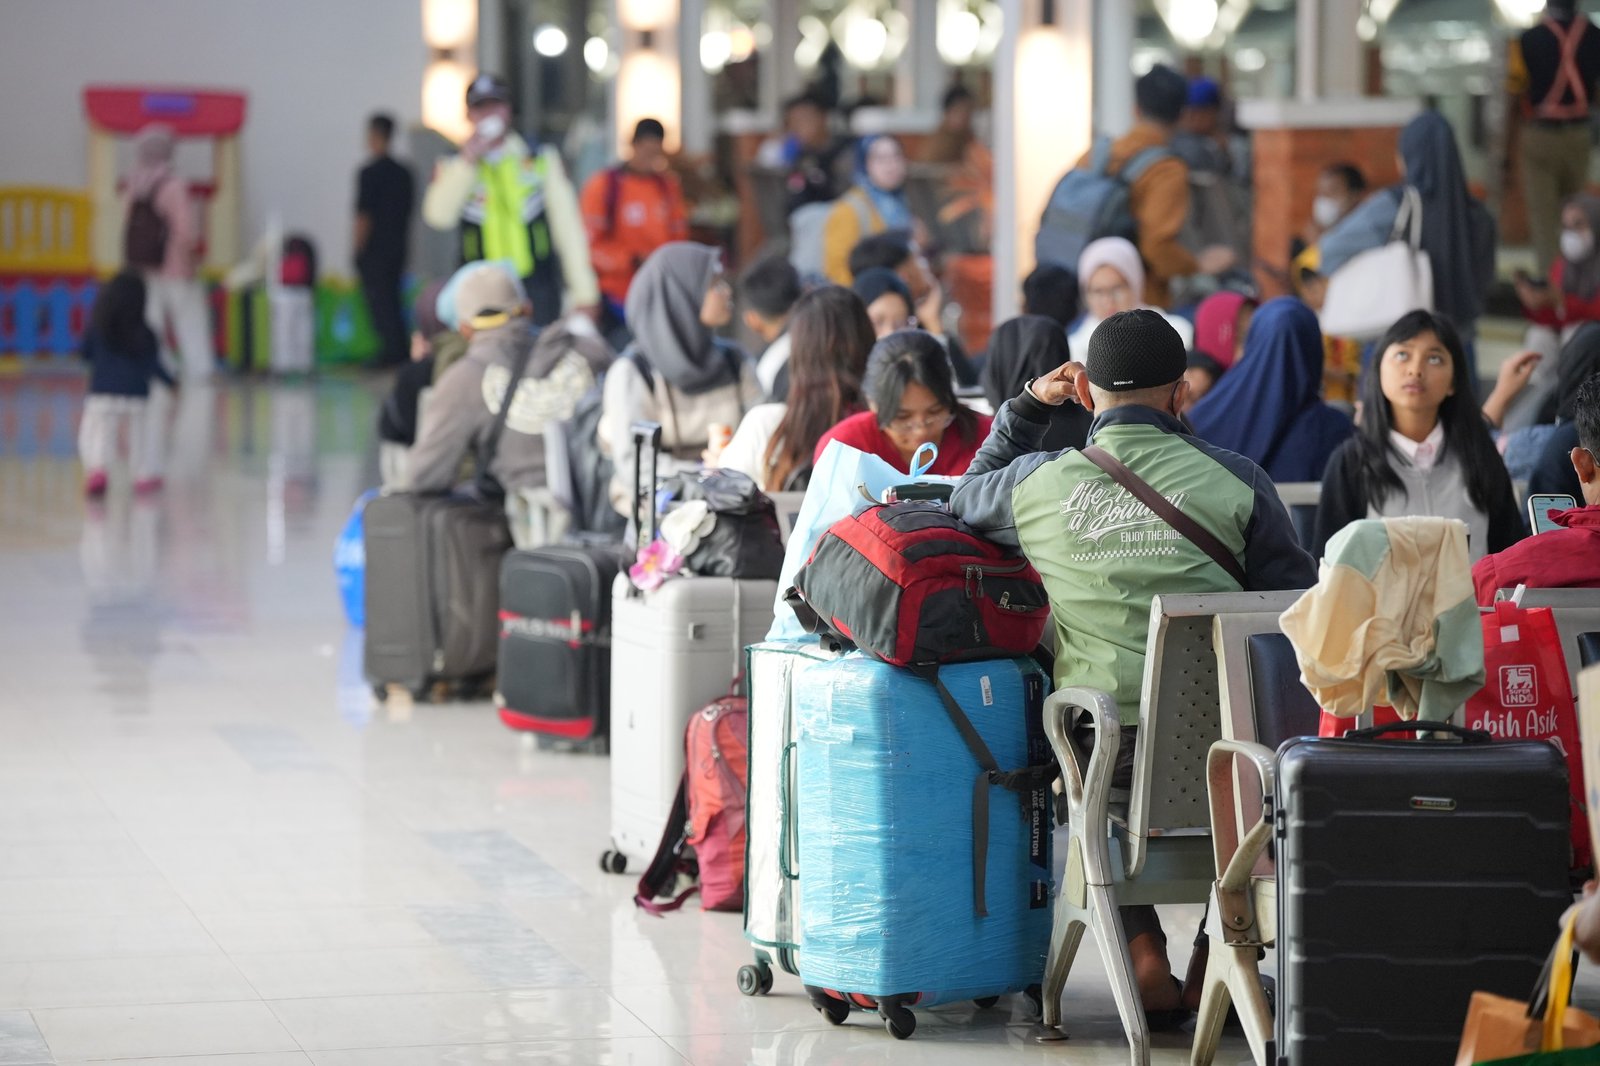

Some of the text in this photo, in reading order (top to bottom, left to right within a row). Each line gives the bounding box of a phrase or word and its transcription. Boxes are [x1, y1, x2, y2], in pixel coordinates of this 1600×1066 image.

[1060, 480, 1111, 516] Life
[1068, 510, 1090, 533] a
[1120, 529, 1183, 542] ENJOY THE RIDE
[1506, 694, 1533, 703] INDO
[1526, 705, 1558, 736] Asik
